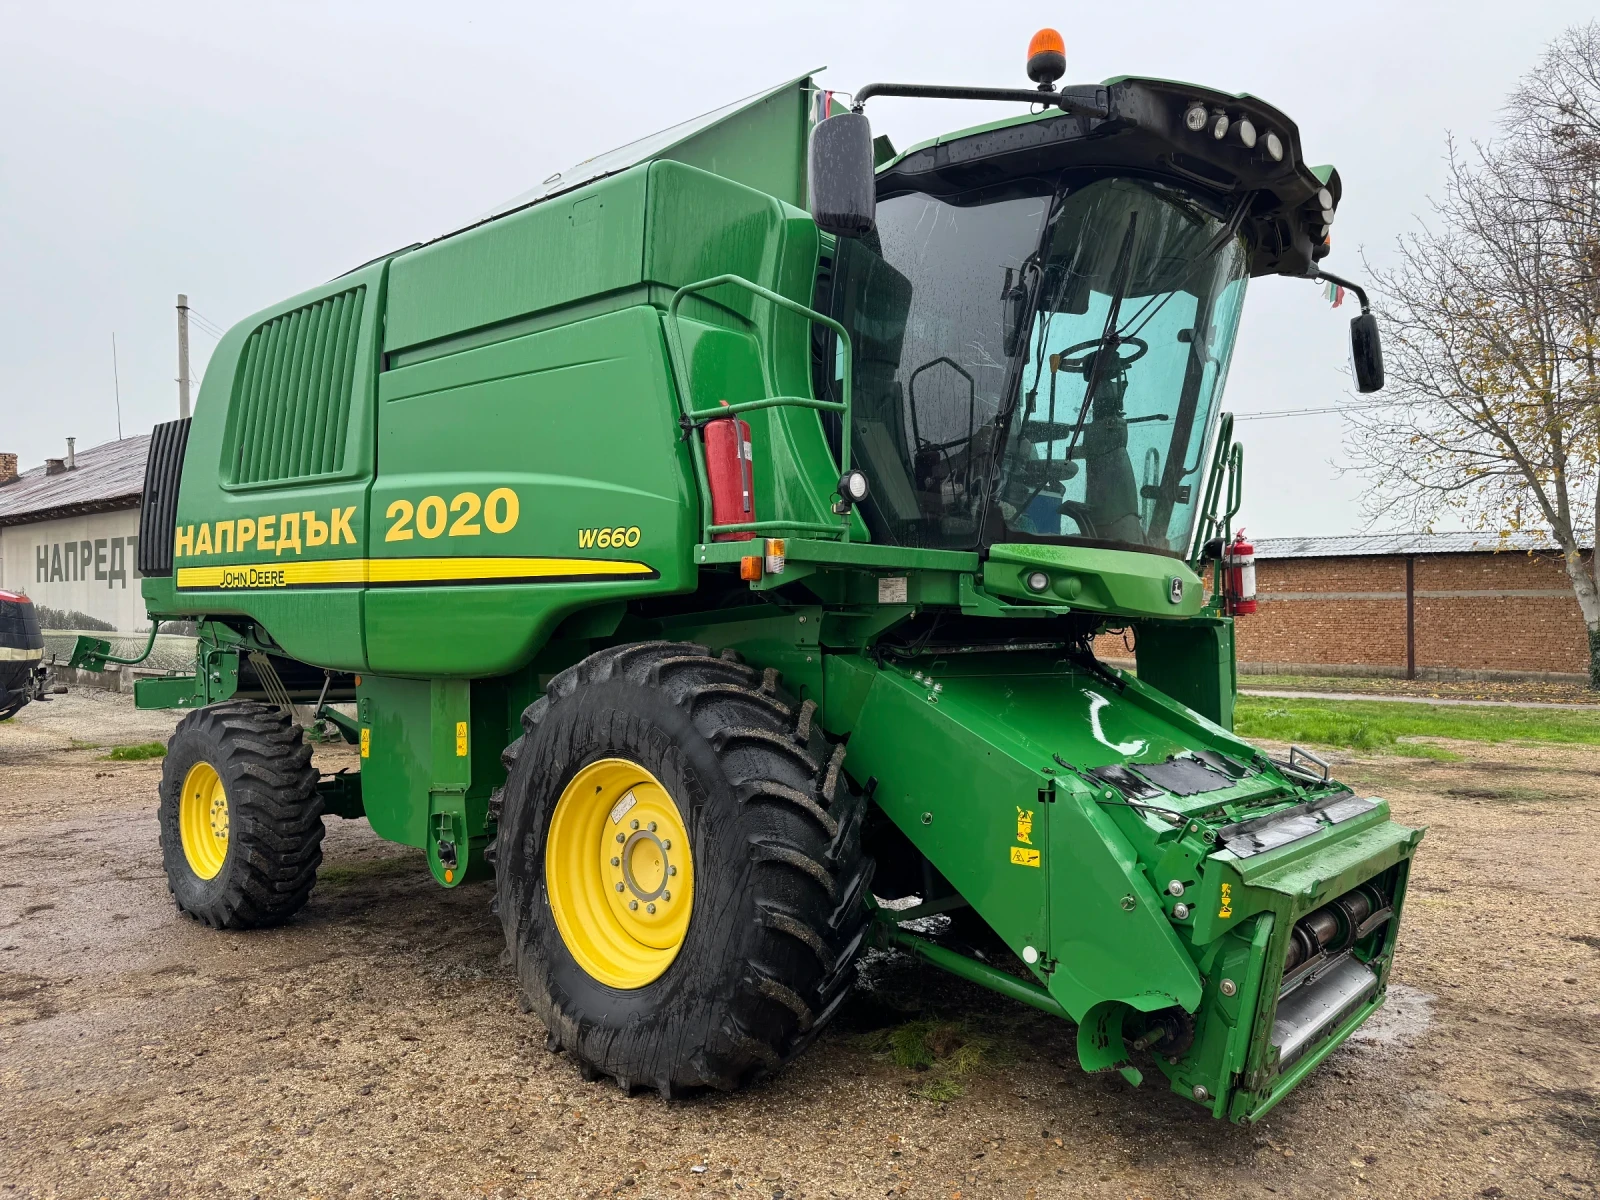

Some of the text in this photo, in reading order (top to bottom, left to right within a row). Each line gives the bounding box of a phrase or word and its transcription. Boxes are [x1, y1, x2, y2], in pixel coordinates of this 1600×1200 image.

[175, 487, 520, 557] НАПРЕДЪК 2020
[578, 525, 641, 549] W660
[219, 568, 285, 588] JOHN DEERE
